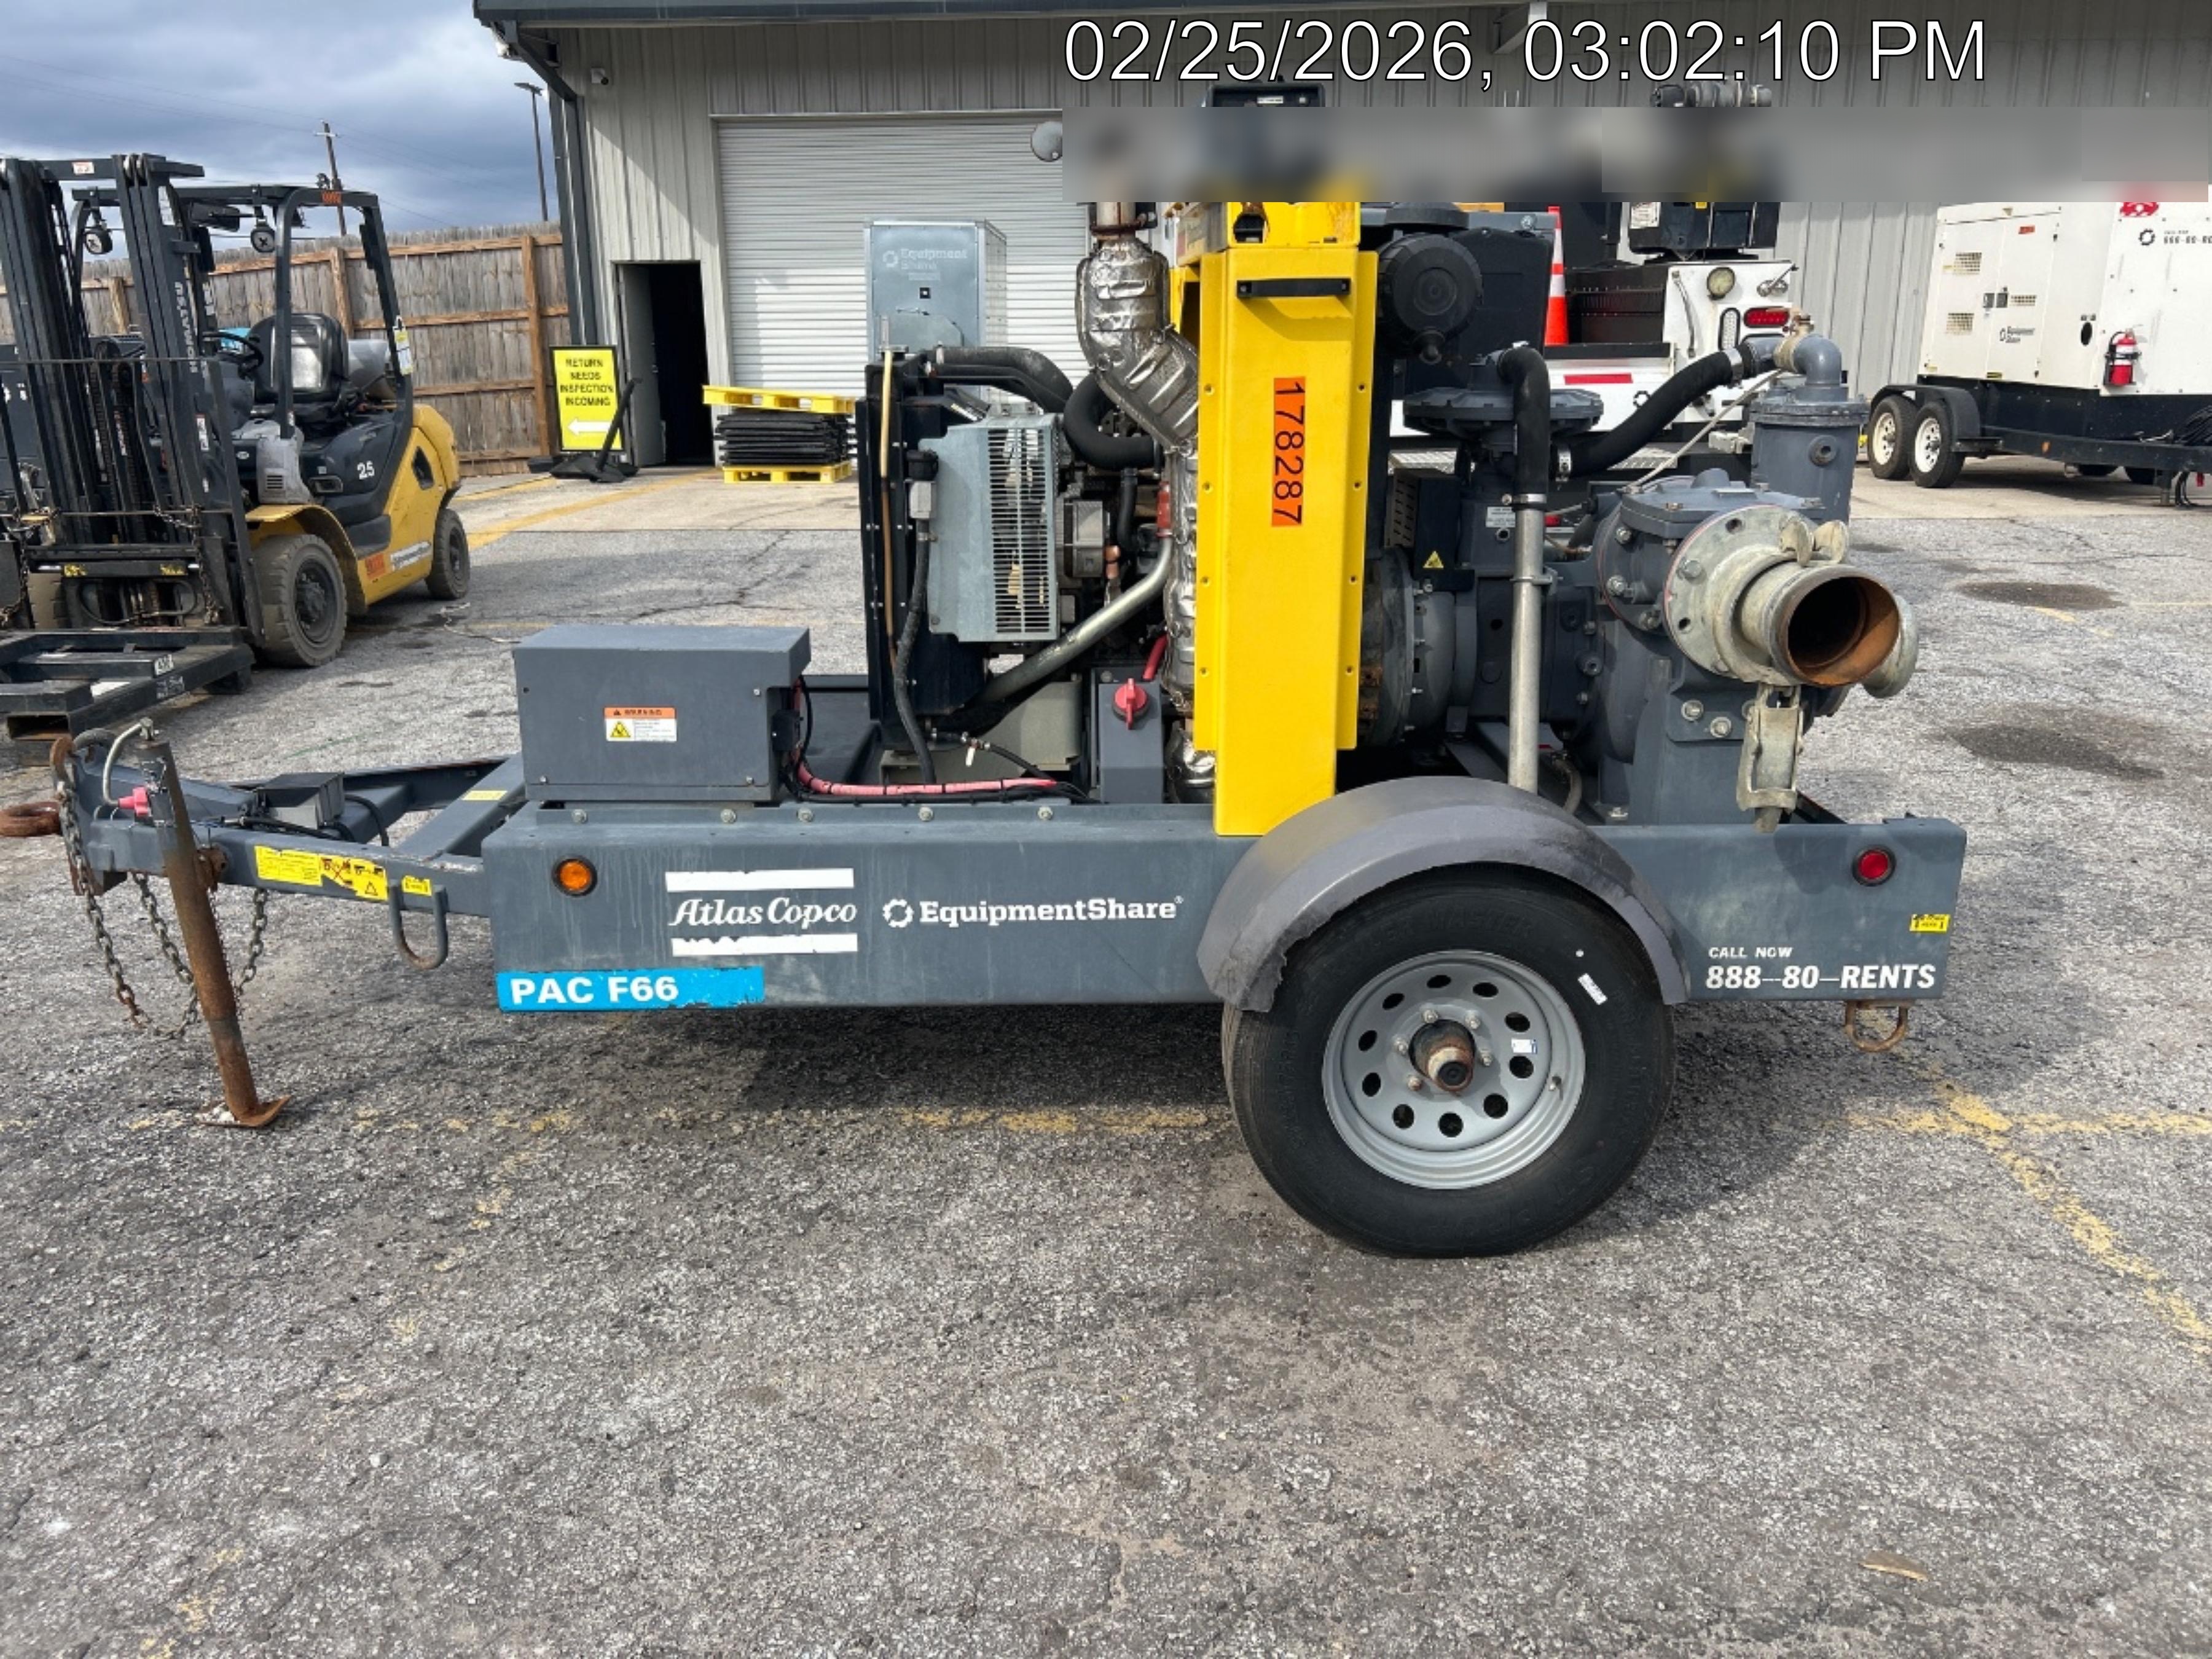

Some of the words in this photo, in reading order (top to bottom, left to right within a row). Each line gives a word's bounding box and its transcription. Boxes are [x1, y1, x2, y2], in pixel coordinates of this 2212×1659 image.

[565, 359, 603, 367] RETURN
[560, 385, 613, 393] INSPECTION
[565, 397, 611, 406] INCOMING
[1274, 381, 1305, 524] 178287
[667, 898, 764, 927] Atlas
[767, 896, 858, 930] Copco
[1708, 946, 1748, 959] CALL
[1754, 946, 1794, 959] NOW
[510, 976, 595, 1005] PAC
[608, 976, 680, 1003] F66
